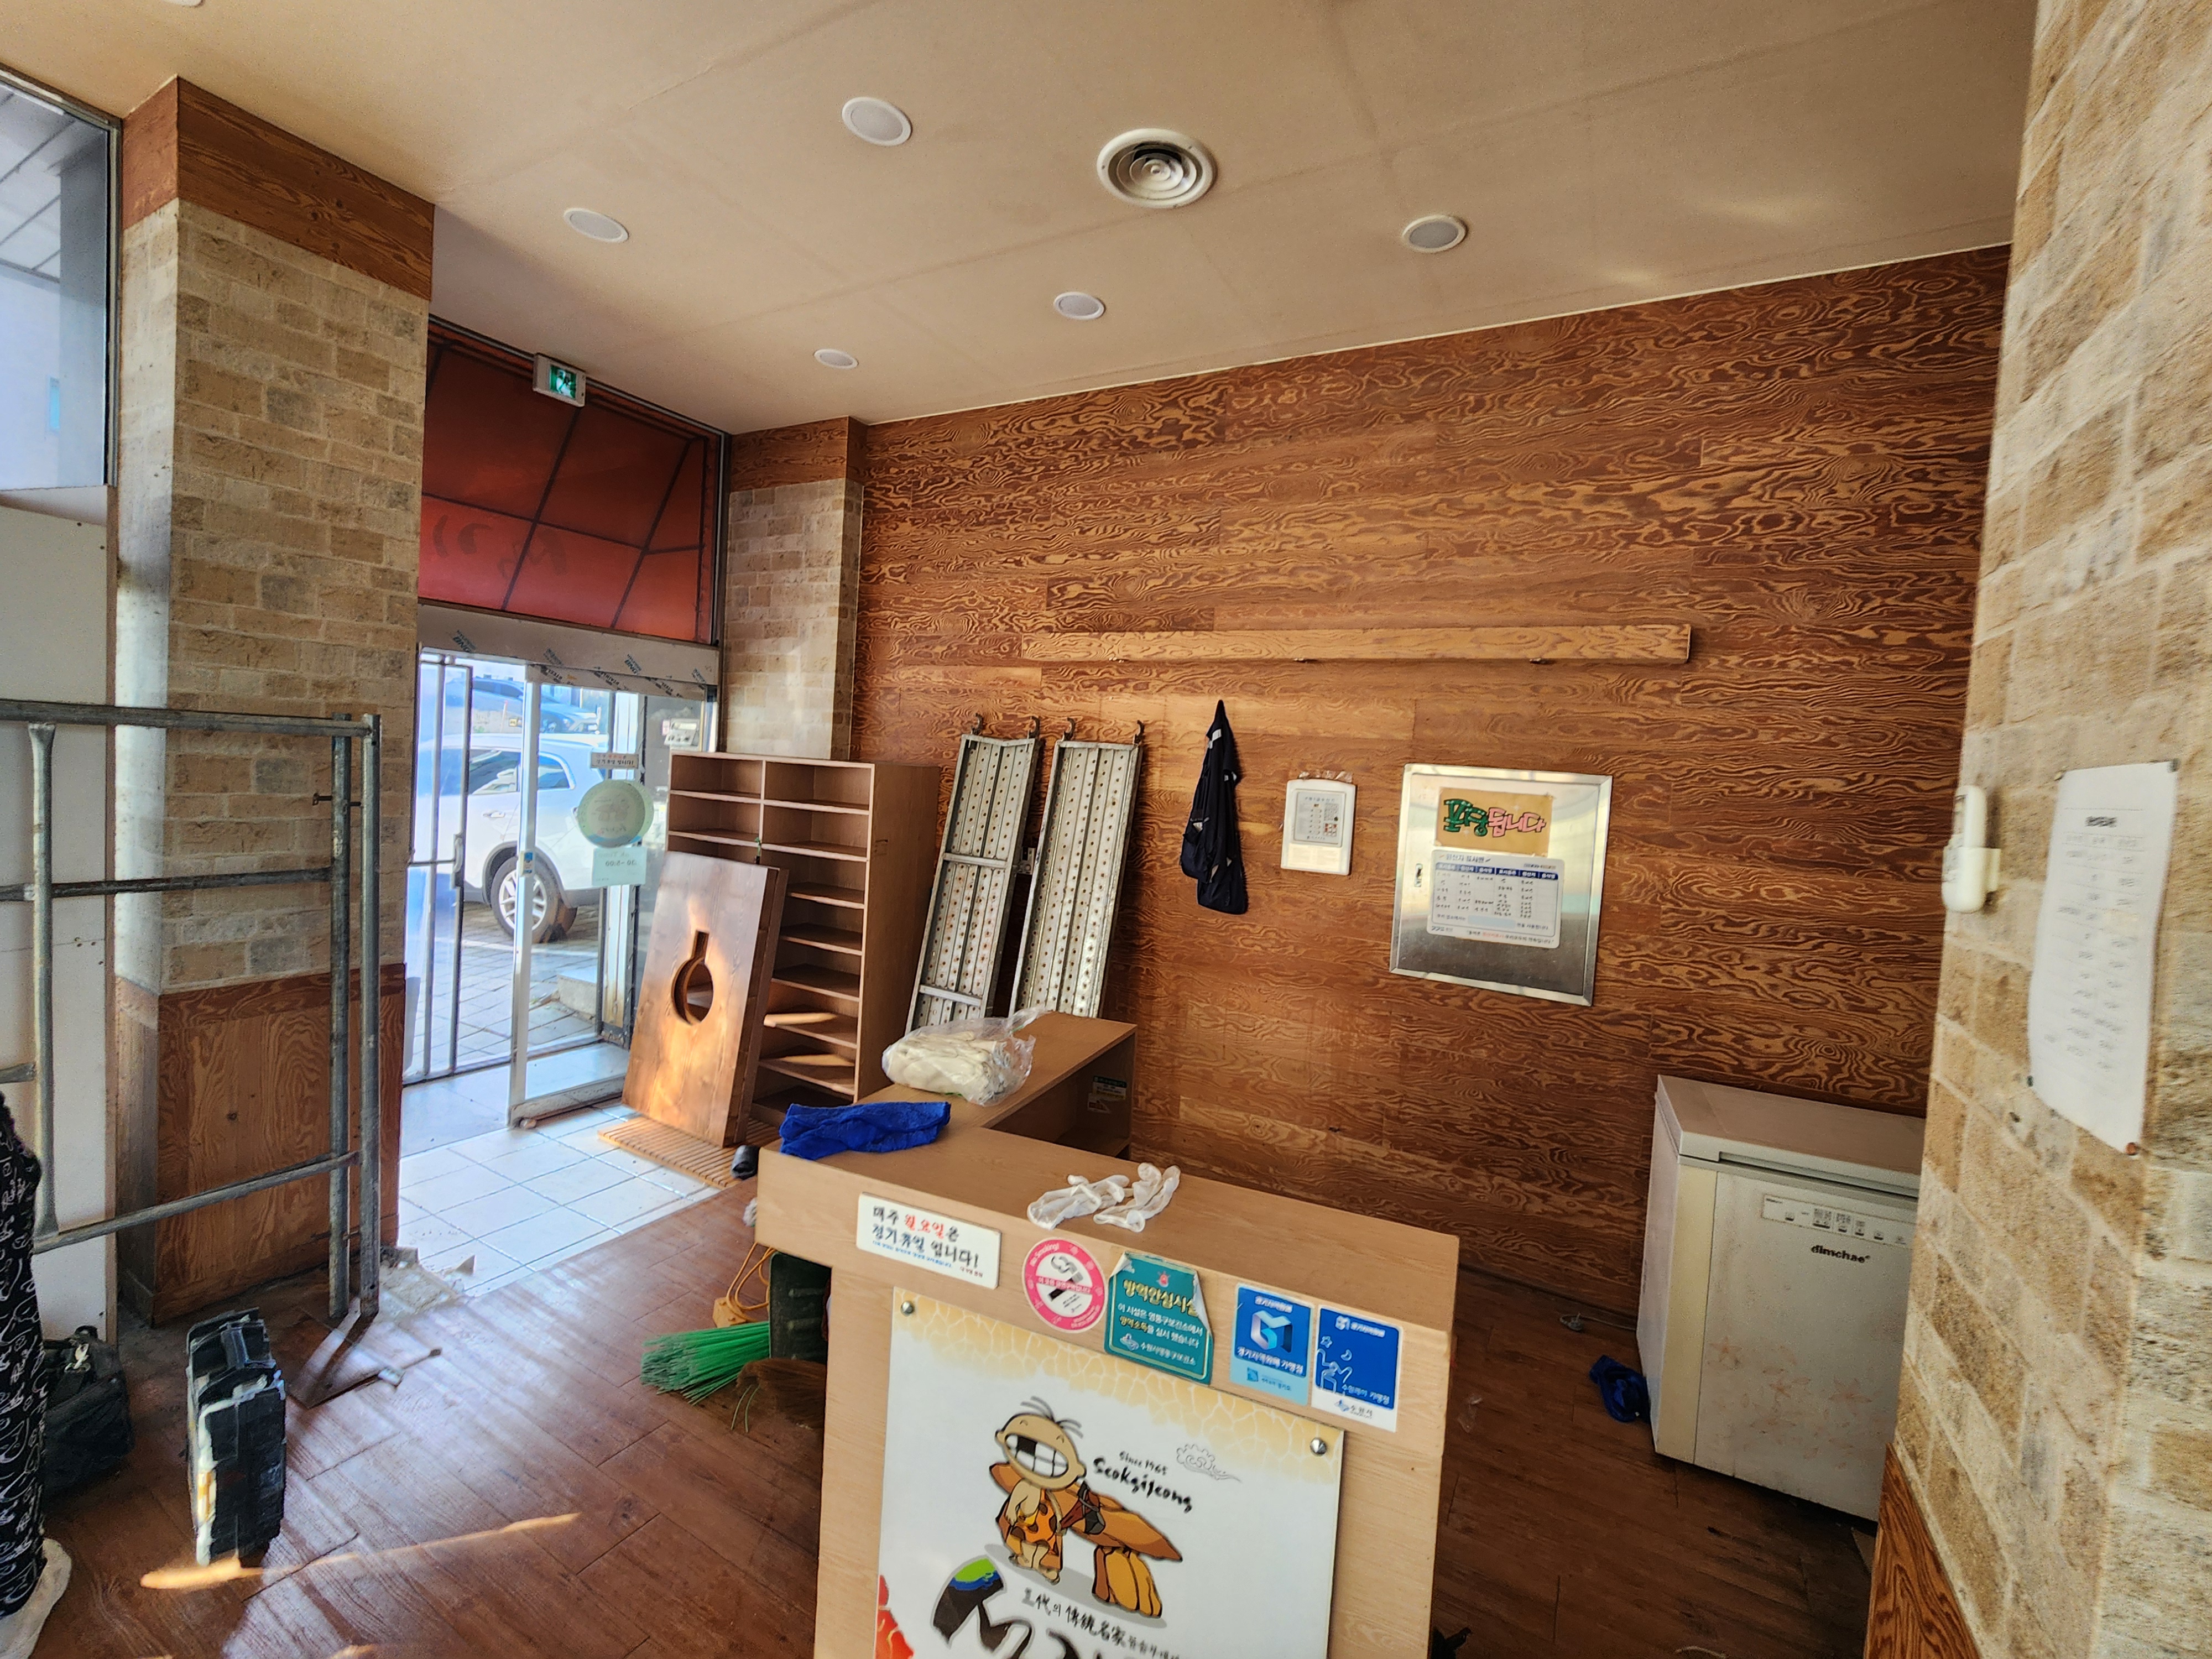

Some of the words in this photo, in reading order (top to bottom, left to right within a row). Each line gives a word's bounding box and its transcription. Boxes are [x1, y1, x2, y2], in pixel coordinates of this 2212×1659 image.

[1443, 798, 1546, 837] 포장됩니다
[873, 1206, 899, 1225] 매주
[905, 1214, 959, 1243] 월요일은
[872, 1223, 925, 1254] 정기휴일
[931, 1240, 979, 1269] 입니다!
[1118, 1303, 1125, 1313] 이
[1127, 1307, 1147, 1319] 시설은
[1148, 1312, 1203, 1337] 영통구보건소에서
[1119, 1316, 1155, 1334] 방역소독을
[1155, 1327, 1170, 1339] 실시
